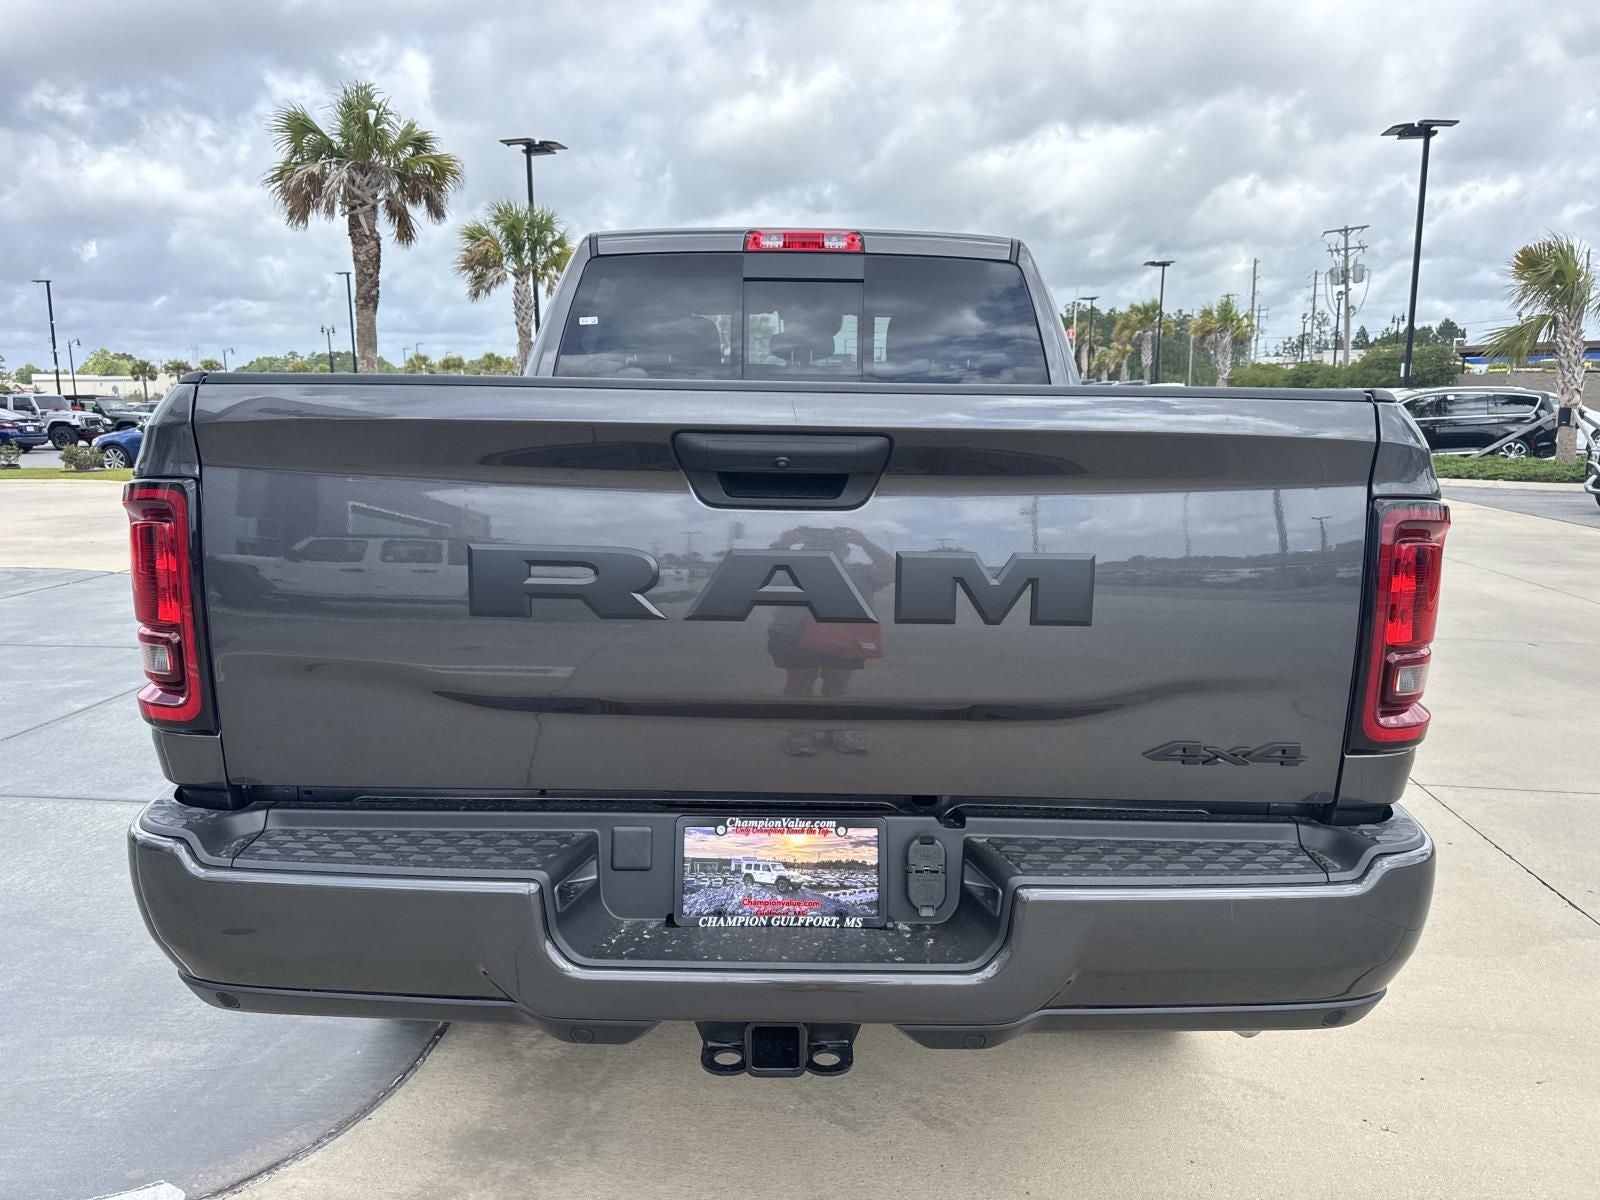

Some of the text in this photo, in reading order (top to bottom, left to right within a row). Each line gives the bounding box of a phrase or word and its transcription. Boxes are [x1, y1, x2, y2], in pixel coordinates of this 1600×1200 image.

[467, 543, 1096, 626] RAM
[1142, 740, 1309, 767] 4x4
[726, 817, 837, 829] ChampionValue.com
[742, 898, 820, 907] Championvalue.com
[698, 916, 863, 929] CHAMPION GULFPORT, MS
